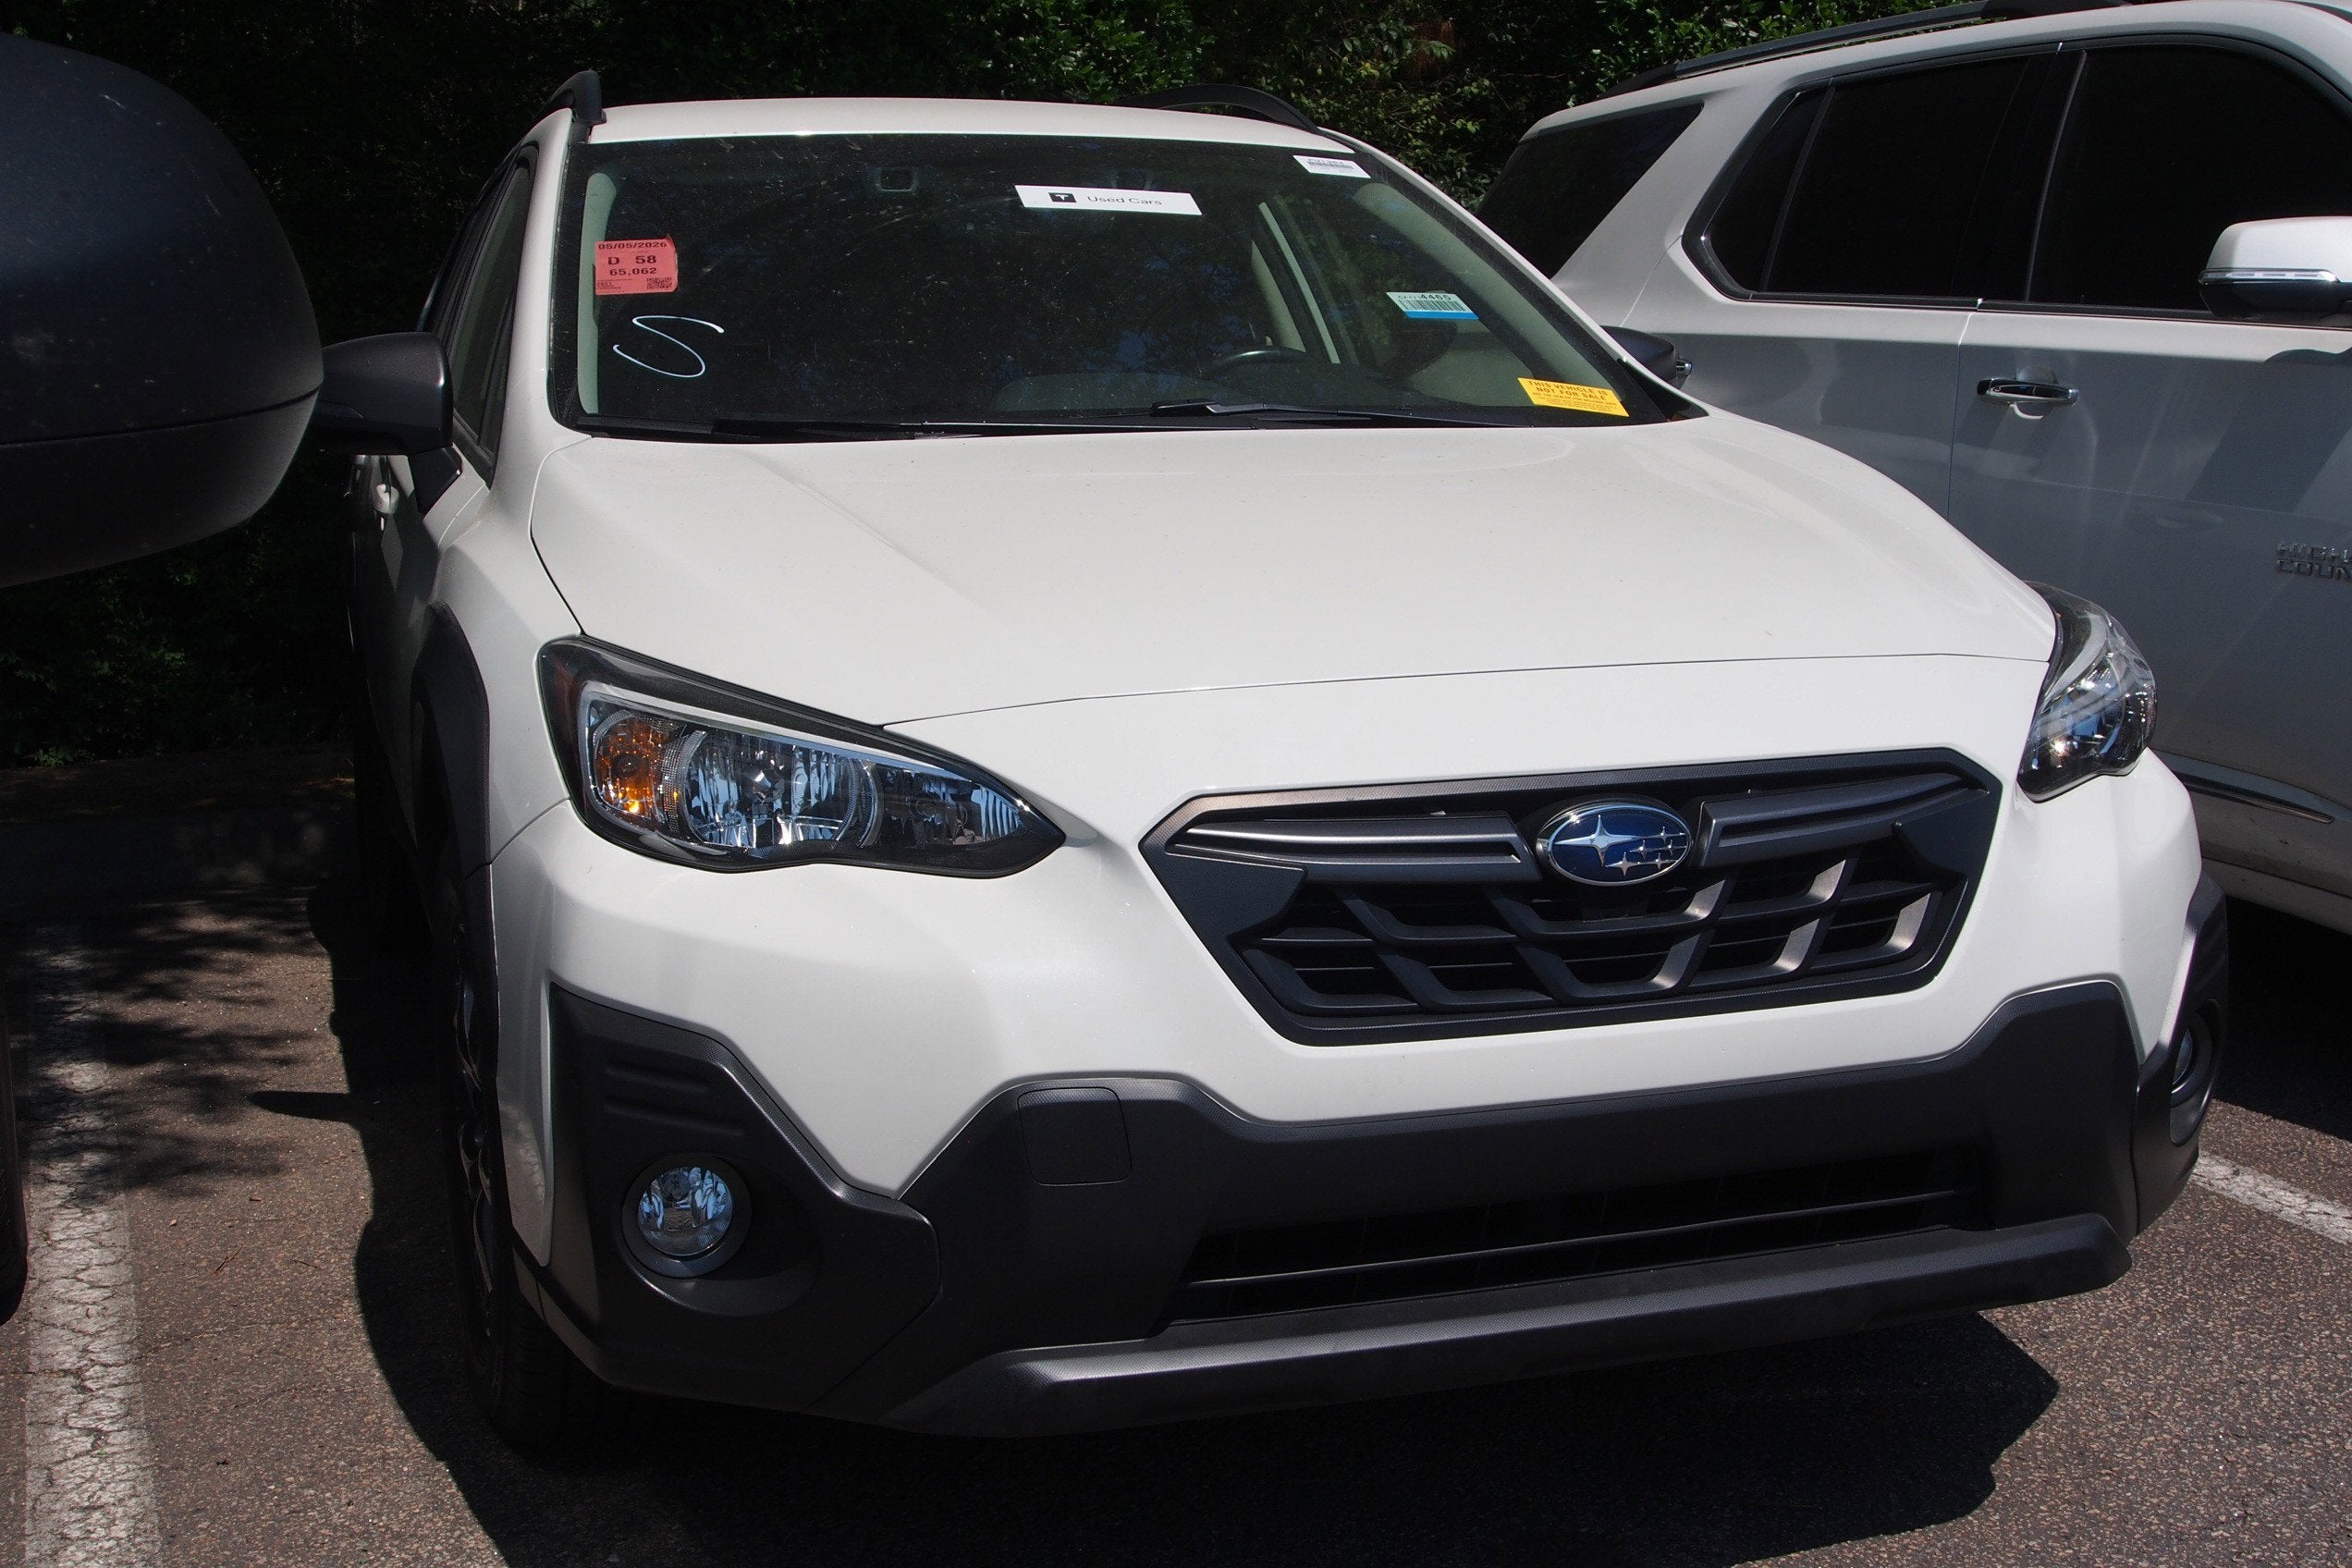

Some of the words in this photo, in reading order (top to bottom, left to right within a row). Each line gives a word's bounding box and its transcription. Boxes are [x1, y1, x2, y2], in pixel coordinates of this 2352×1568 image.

[1087, 195, 1125, 204] Used
[1128, 197, 1163, 206] Cars
[598, 241, 668, 250] 05/05/2026
[607, 256, 620, 265] D
[635, 255, 657, 264] 58
[609, 267, 657, 276] 65,062
[1528, 380, 1551, 388] THIS
[1555, 384, 1596, 394] VEHICLE
[1582, 392, 1606, 401] SALE
